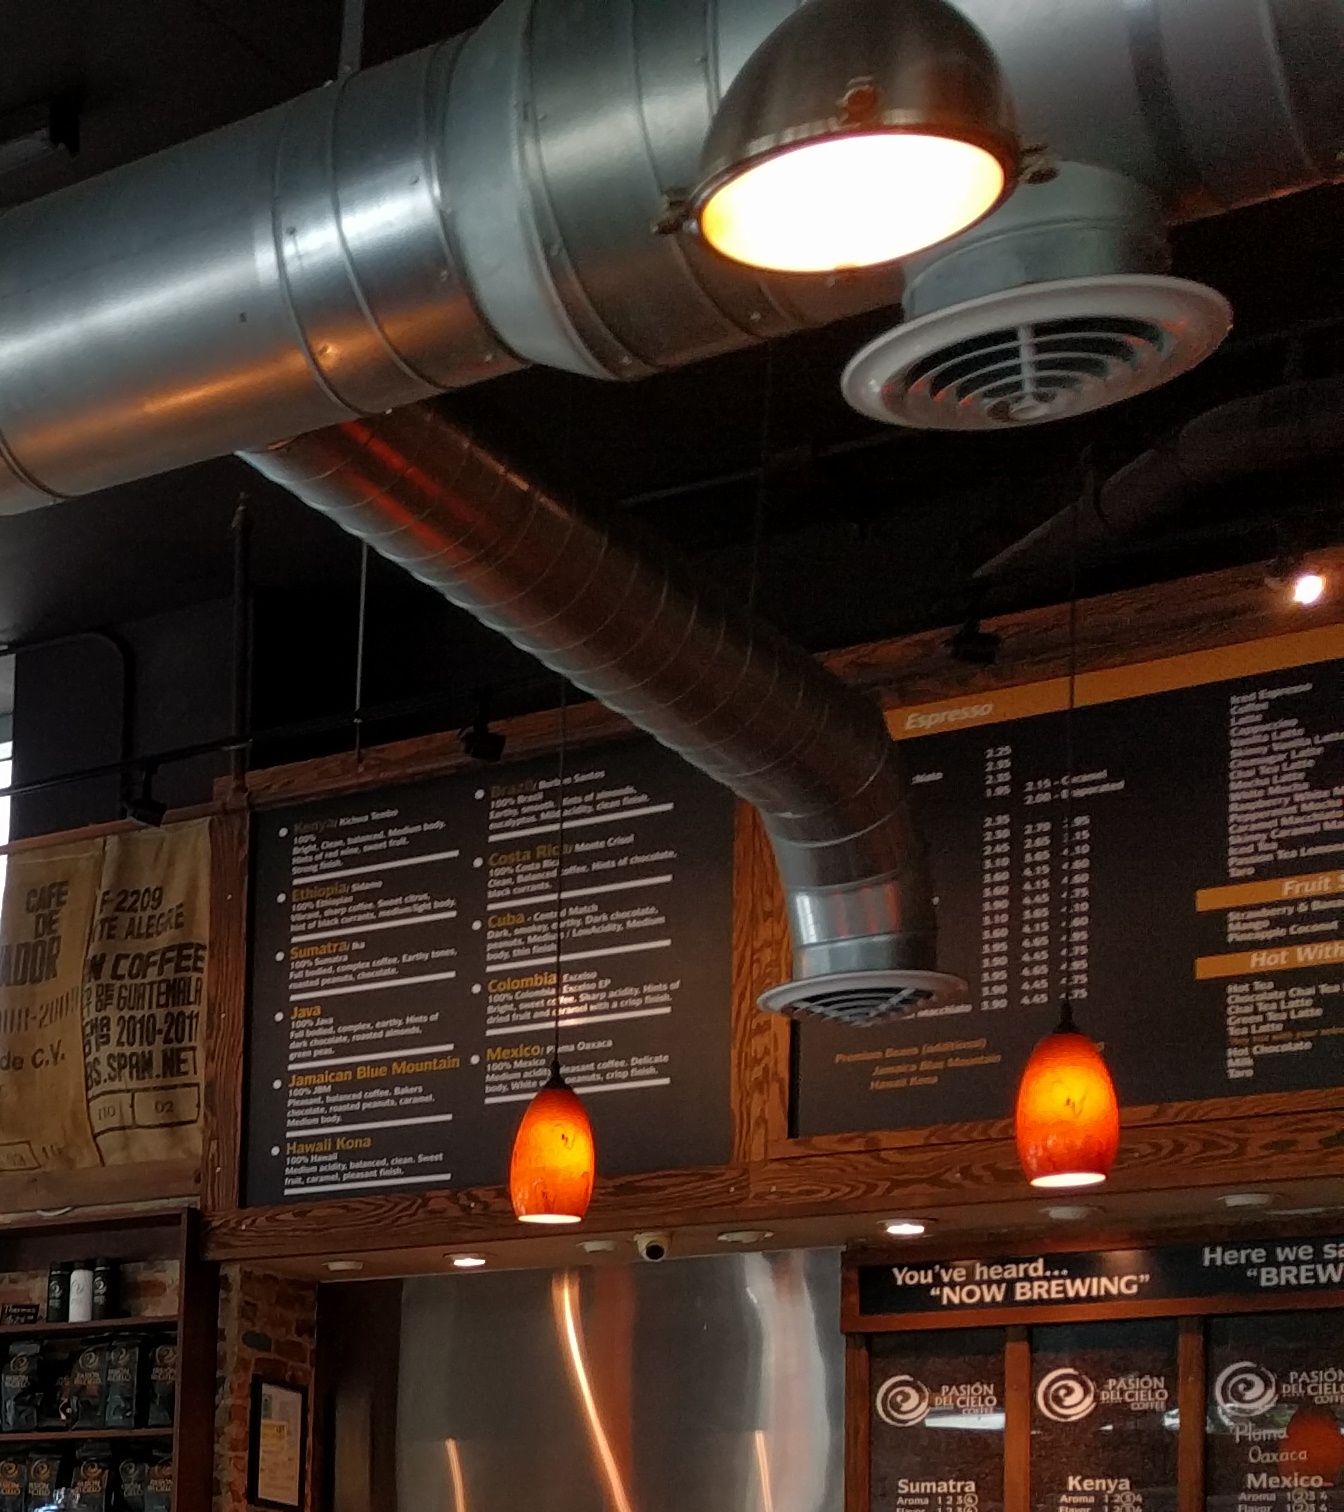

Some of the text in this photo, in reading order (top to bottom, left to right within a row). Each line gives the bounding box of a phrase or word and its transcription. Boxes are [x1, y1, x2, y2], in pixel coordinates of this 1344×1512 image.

[905, 702, 995, 730] Espresso
[1283, 876, 1332, 897] Fruit
[26, 880, 68, 913] CAFE
[35, 910, 60, 939] DE
[124, 903, 184, 940] ALEGRE
[487, 910, 525, 928] Cuba
[584, 913, 608, 924] Dark
[112, 942, 207, 982] COFFEE
[290, 953, 348, 969] 100% Sumatra
[336, 960, 369, 973] complex
[1250, 950, 1287, 969] Hot
[487, 970, 556, 993] Colombia
[116, 977, 202, 1012] GUATEMALA
[488, 992, 512, 1003] 100%
[290, 1002, 321, 1019] Java
[289, 1030, 304, 1041] Full
[405, 1013, 427, 1025] Hints
[429, 1011, 439, 1021] of
[291, 1015, 333, 1029] 100% Java
[289, 1040, 307, 1050] dark
[352, 1030, 383, 1042] roasted
[577, 1037, 612, 1051] Oaxaca
[288, 1050, 311, 1060] green
[287, 1053, 460, 1088] Jamaican Blue Mountain
[485, 1070, 521, 1083] Medium
[630, 1053, 669, 1066] Delicate
[487, 1057, 545, 1072] 100% Mexico
[511, 1069, 628, 1091] White crisp
[288, 1086, 311, 1097] 100%
[326, 1091, 361, 1103] balanced
[394, 1083, 422, 1095] Bakers
[329, 1102, 359, 1114] roasted
[286, 1116, 318, 1128] Medium
[285, 1134, 371, 1155] Hawaii Kona
[284, 1165, 317, 1176] Medium
[417, 1151, 443, 1163] Sweet
[285, 1152, 337, 1165] 100% Hawaii
[343, 1168, 377, 1181] pleasant
[1202, 1246, 1268, 1267] Here
[1276, 1245, 1314, 1262] we
[892, 1264, 967, 1288] You've
[941, 1381, 994, 1397] PASIÓN
[1108, 1375, 1164, 1390] PASIÓN
[1282, 1383, 1305, 1395] DEL
[934, 1396, 997, 1408] DEL CIELO
[1101, 1389, 1168, 1402] DEL CIELO
[1248, 1445, 1308, 1464] Oaxaca
[898, 1479, 976, 1494] Sumatra
[1068, 1476, 1130, 1493] Kenya
[1246, 1473, 1324, 1489] Mexico
[896, 1496, 929, 1505] Aroma
[1059, 1494, 1095, 1504] Aroma
[1238, 1492, 1276, 1502] Aroma
